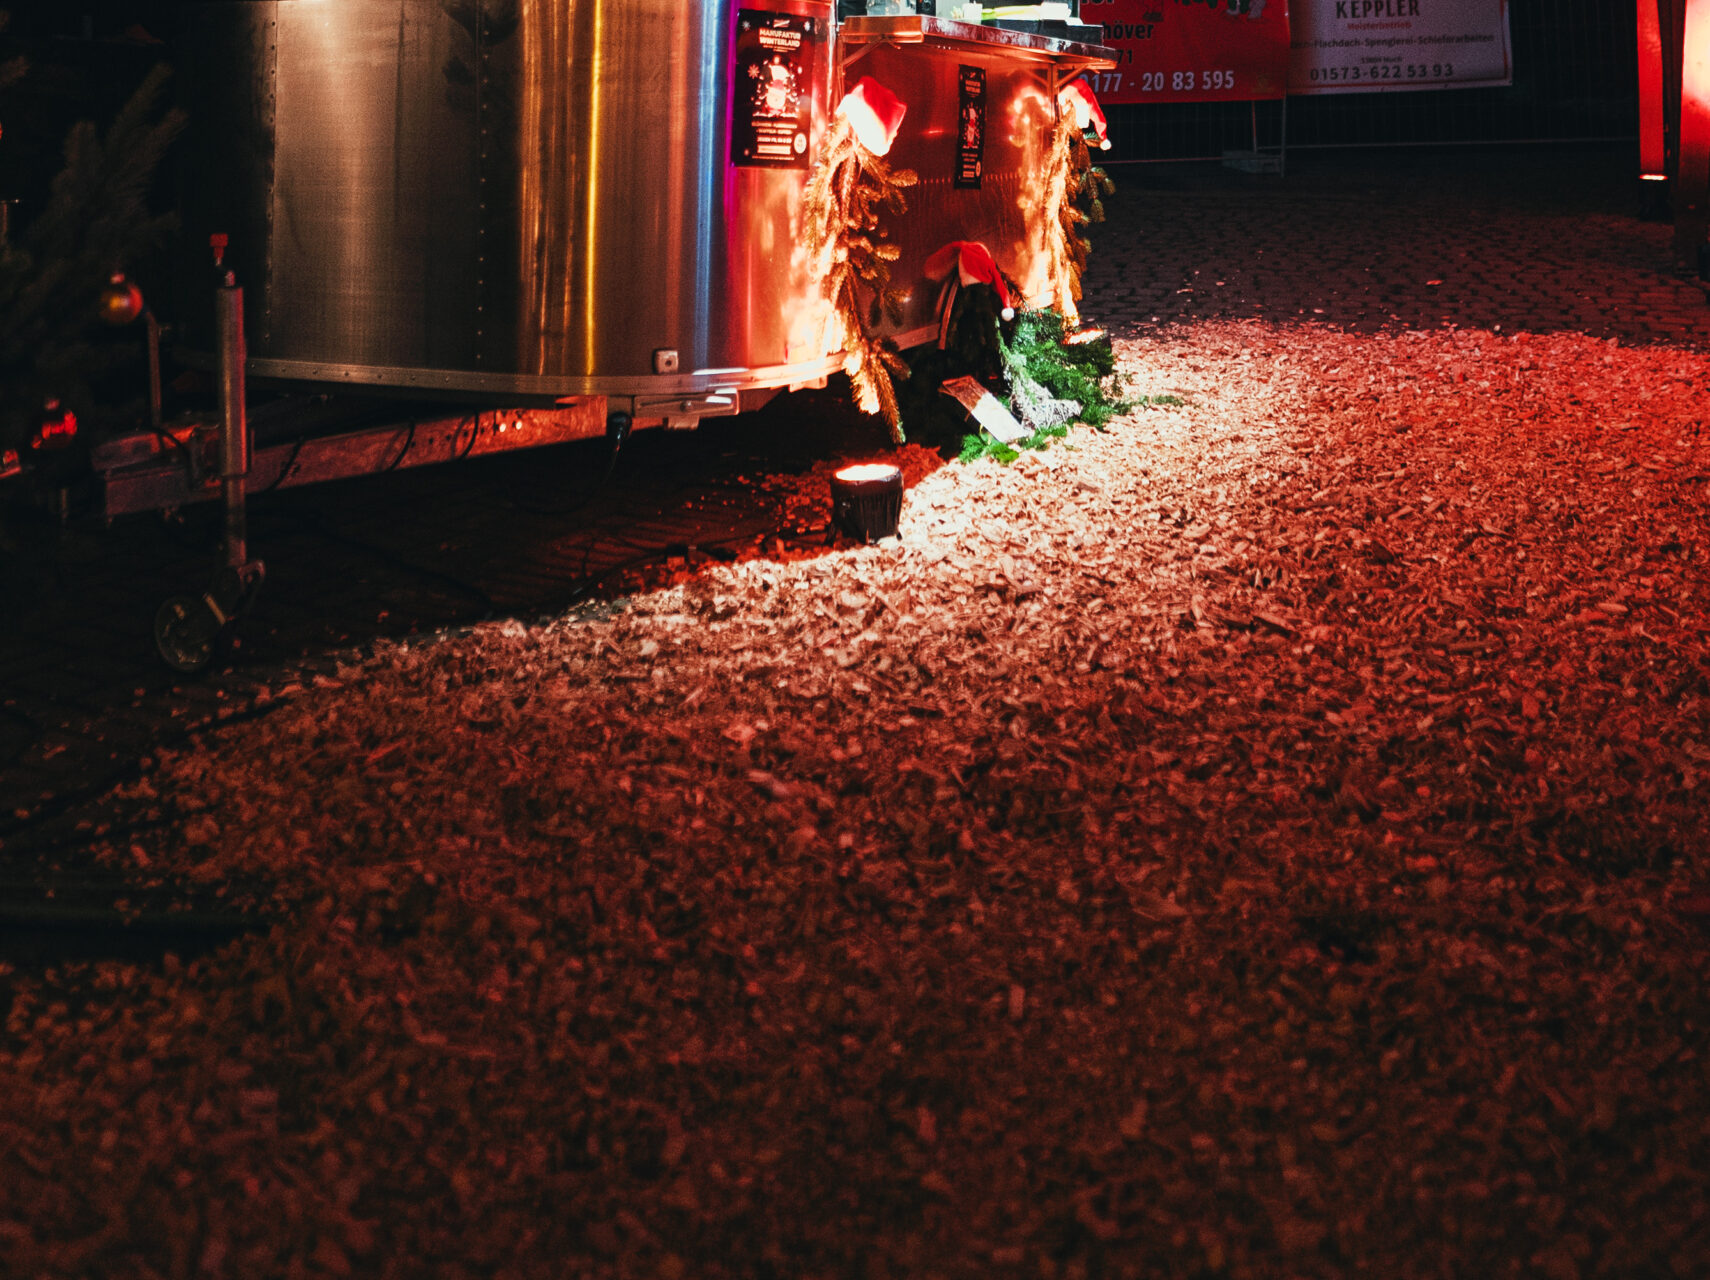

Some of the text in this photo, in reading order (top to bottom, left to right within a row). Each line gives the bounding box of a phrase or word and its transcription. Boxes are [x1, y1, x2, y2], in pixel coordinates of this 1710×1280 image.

[759, 37, 801, 48] WINTERLAND
[1141, 71, 1165, 92] 20
[1172, 71, 1195, 91] 83
[1202, 70, 1236, 90] 595
[1310, 64, 1454, 81] 01573-622 53 93
